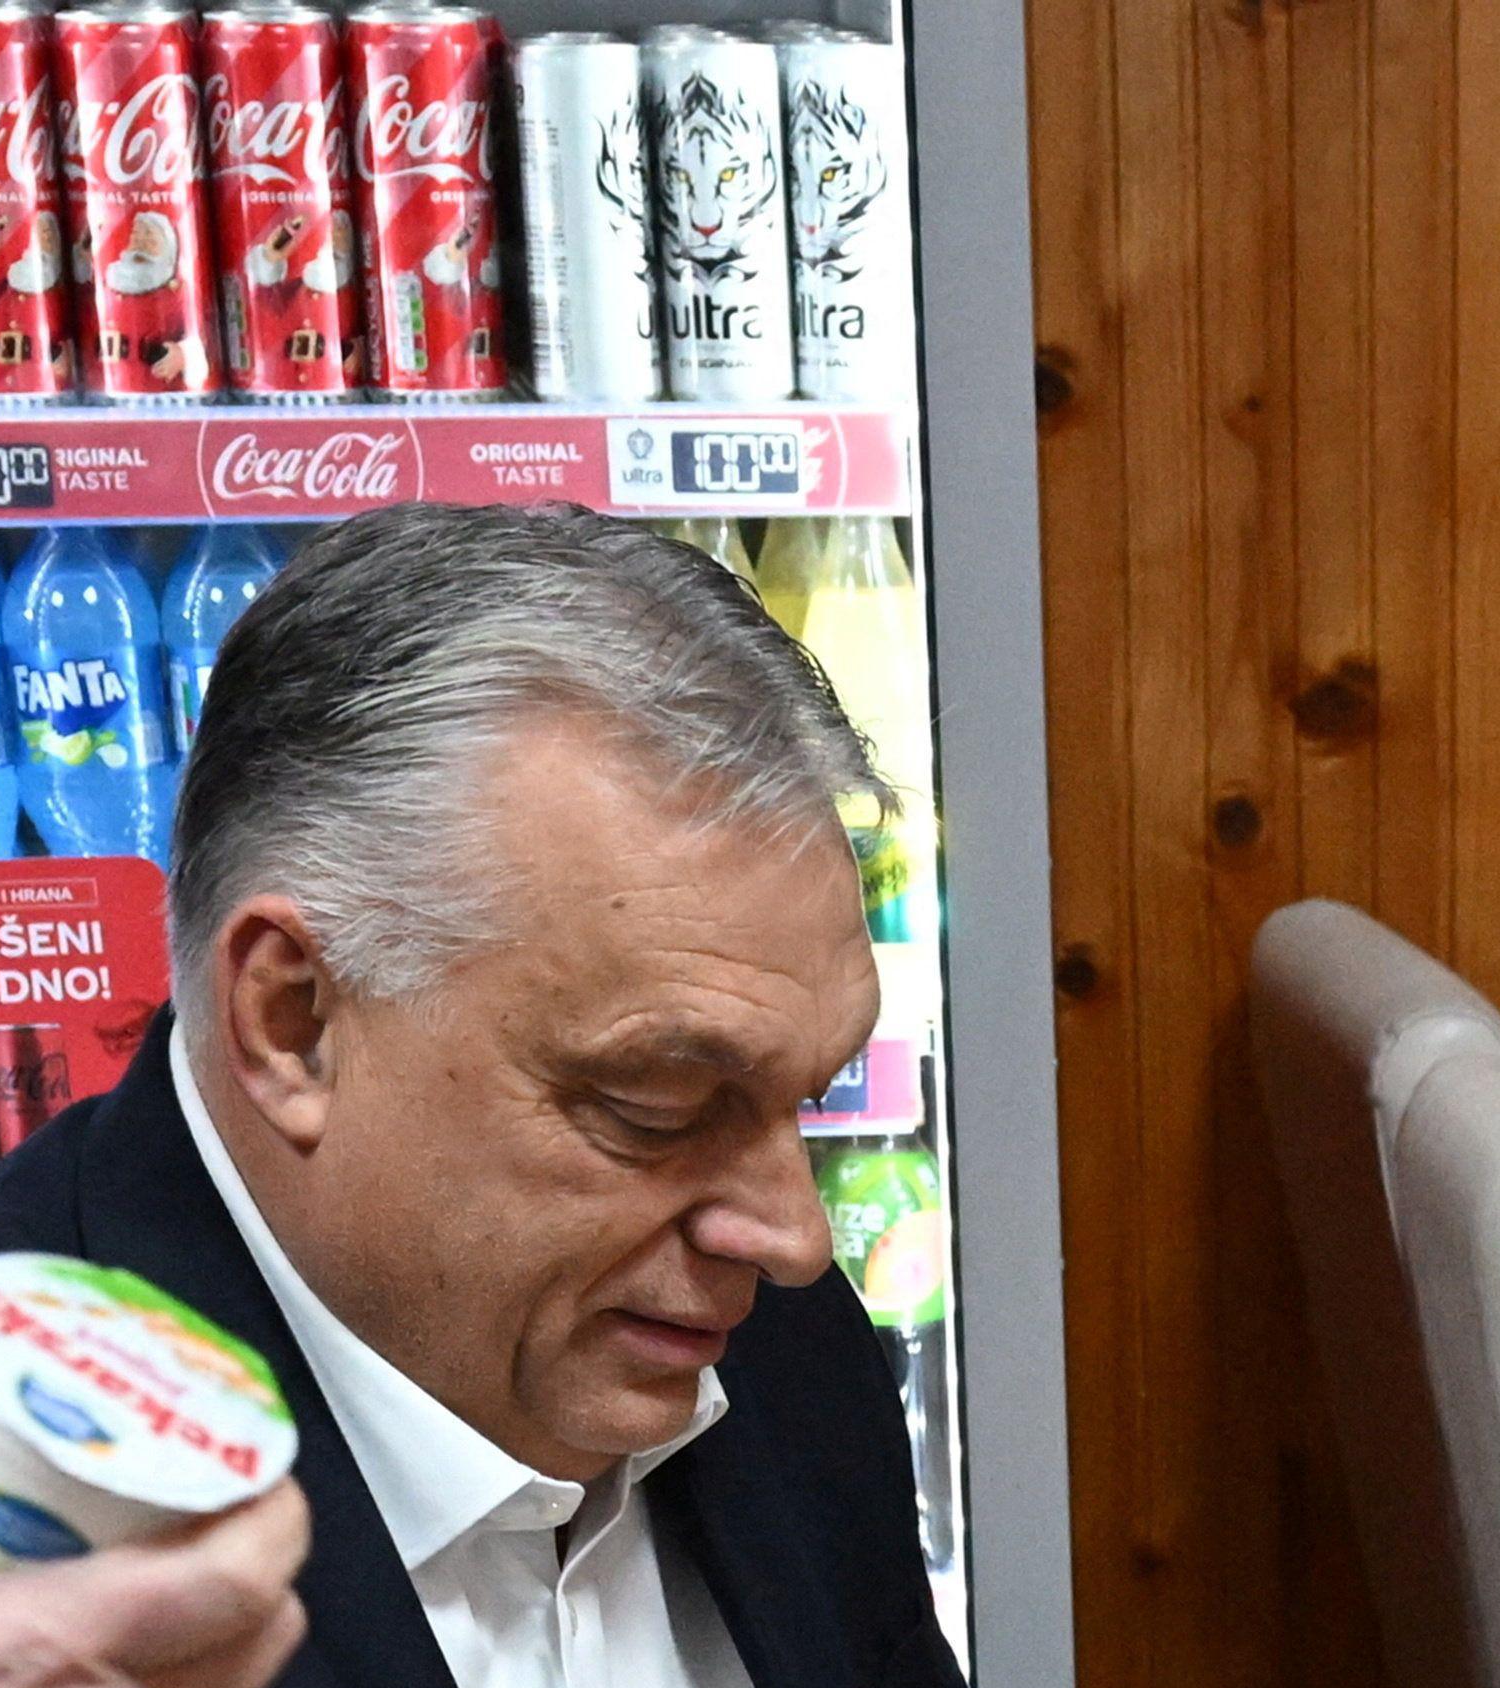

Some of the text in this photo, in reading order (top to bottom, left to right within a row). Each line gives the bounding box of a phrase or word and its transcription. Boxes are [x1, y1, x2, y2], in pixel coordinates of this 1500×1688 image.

[670, 294, 764, 340] ultra
[797, 294, 864, 340] ltra
[469, 442, 583, 465] ORIGINAL
[213, 433, 406, 500] Coca-Cola
[493, 466, 565, 486] TASTE
[622, 467, 663, 484] ultra
[58, 470, 129, 491] TASTE
[13, 660, 127, 713] FANTA
[10, 886, 74, 904] HRANA
